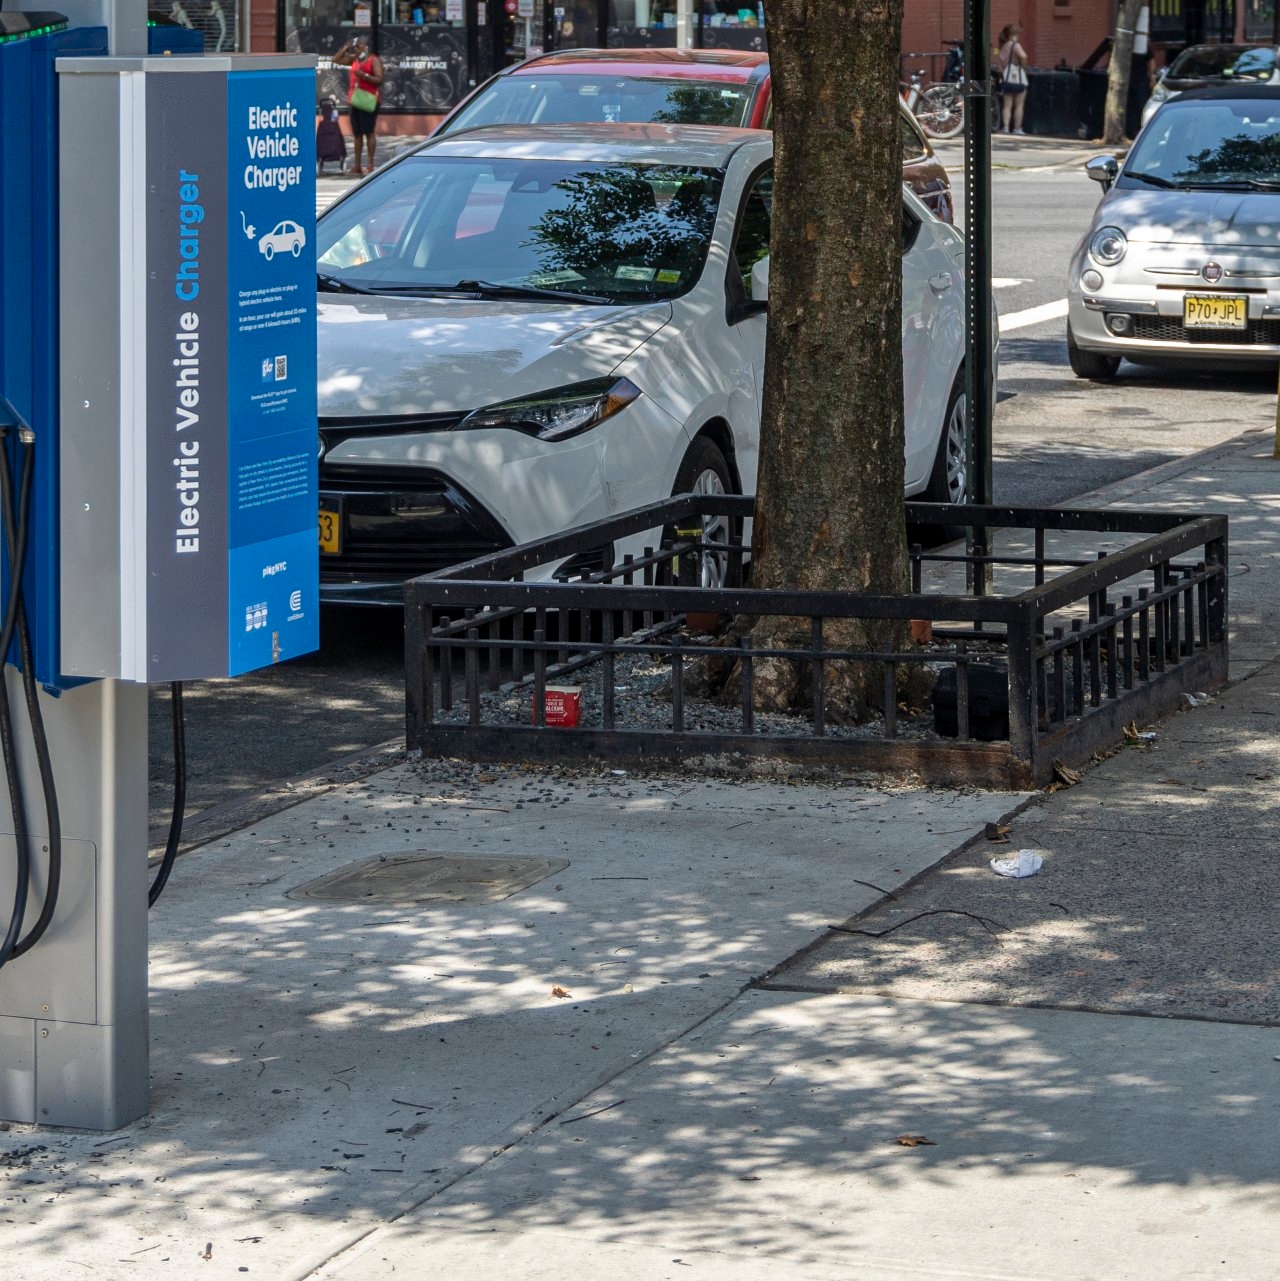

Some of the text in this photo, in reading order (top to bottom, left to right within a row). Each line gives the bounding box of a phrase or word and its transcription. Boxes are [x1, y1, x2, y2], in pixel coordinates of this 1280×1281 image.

[248, 101, 298, 130] Electric
[247, 134, 299, 159] Vehicle
[244, 165, 302, 192] Charger
[1188, 301, 1242, 320] P70 JPL
[173, 169, 205, 553] Electric Vehicle Charger
[245, 608, 268, 632] DOT
